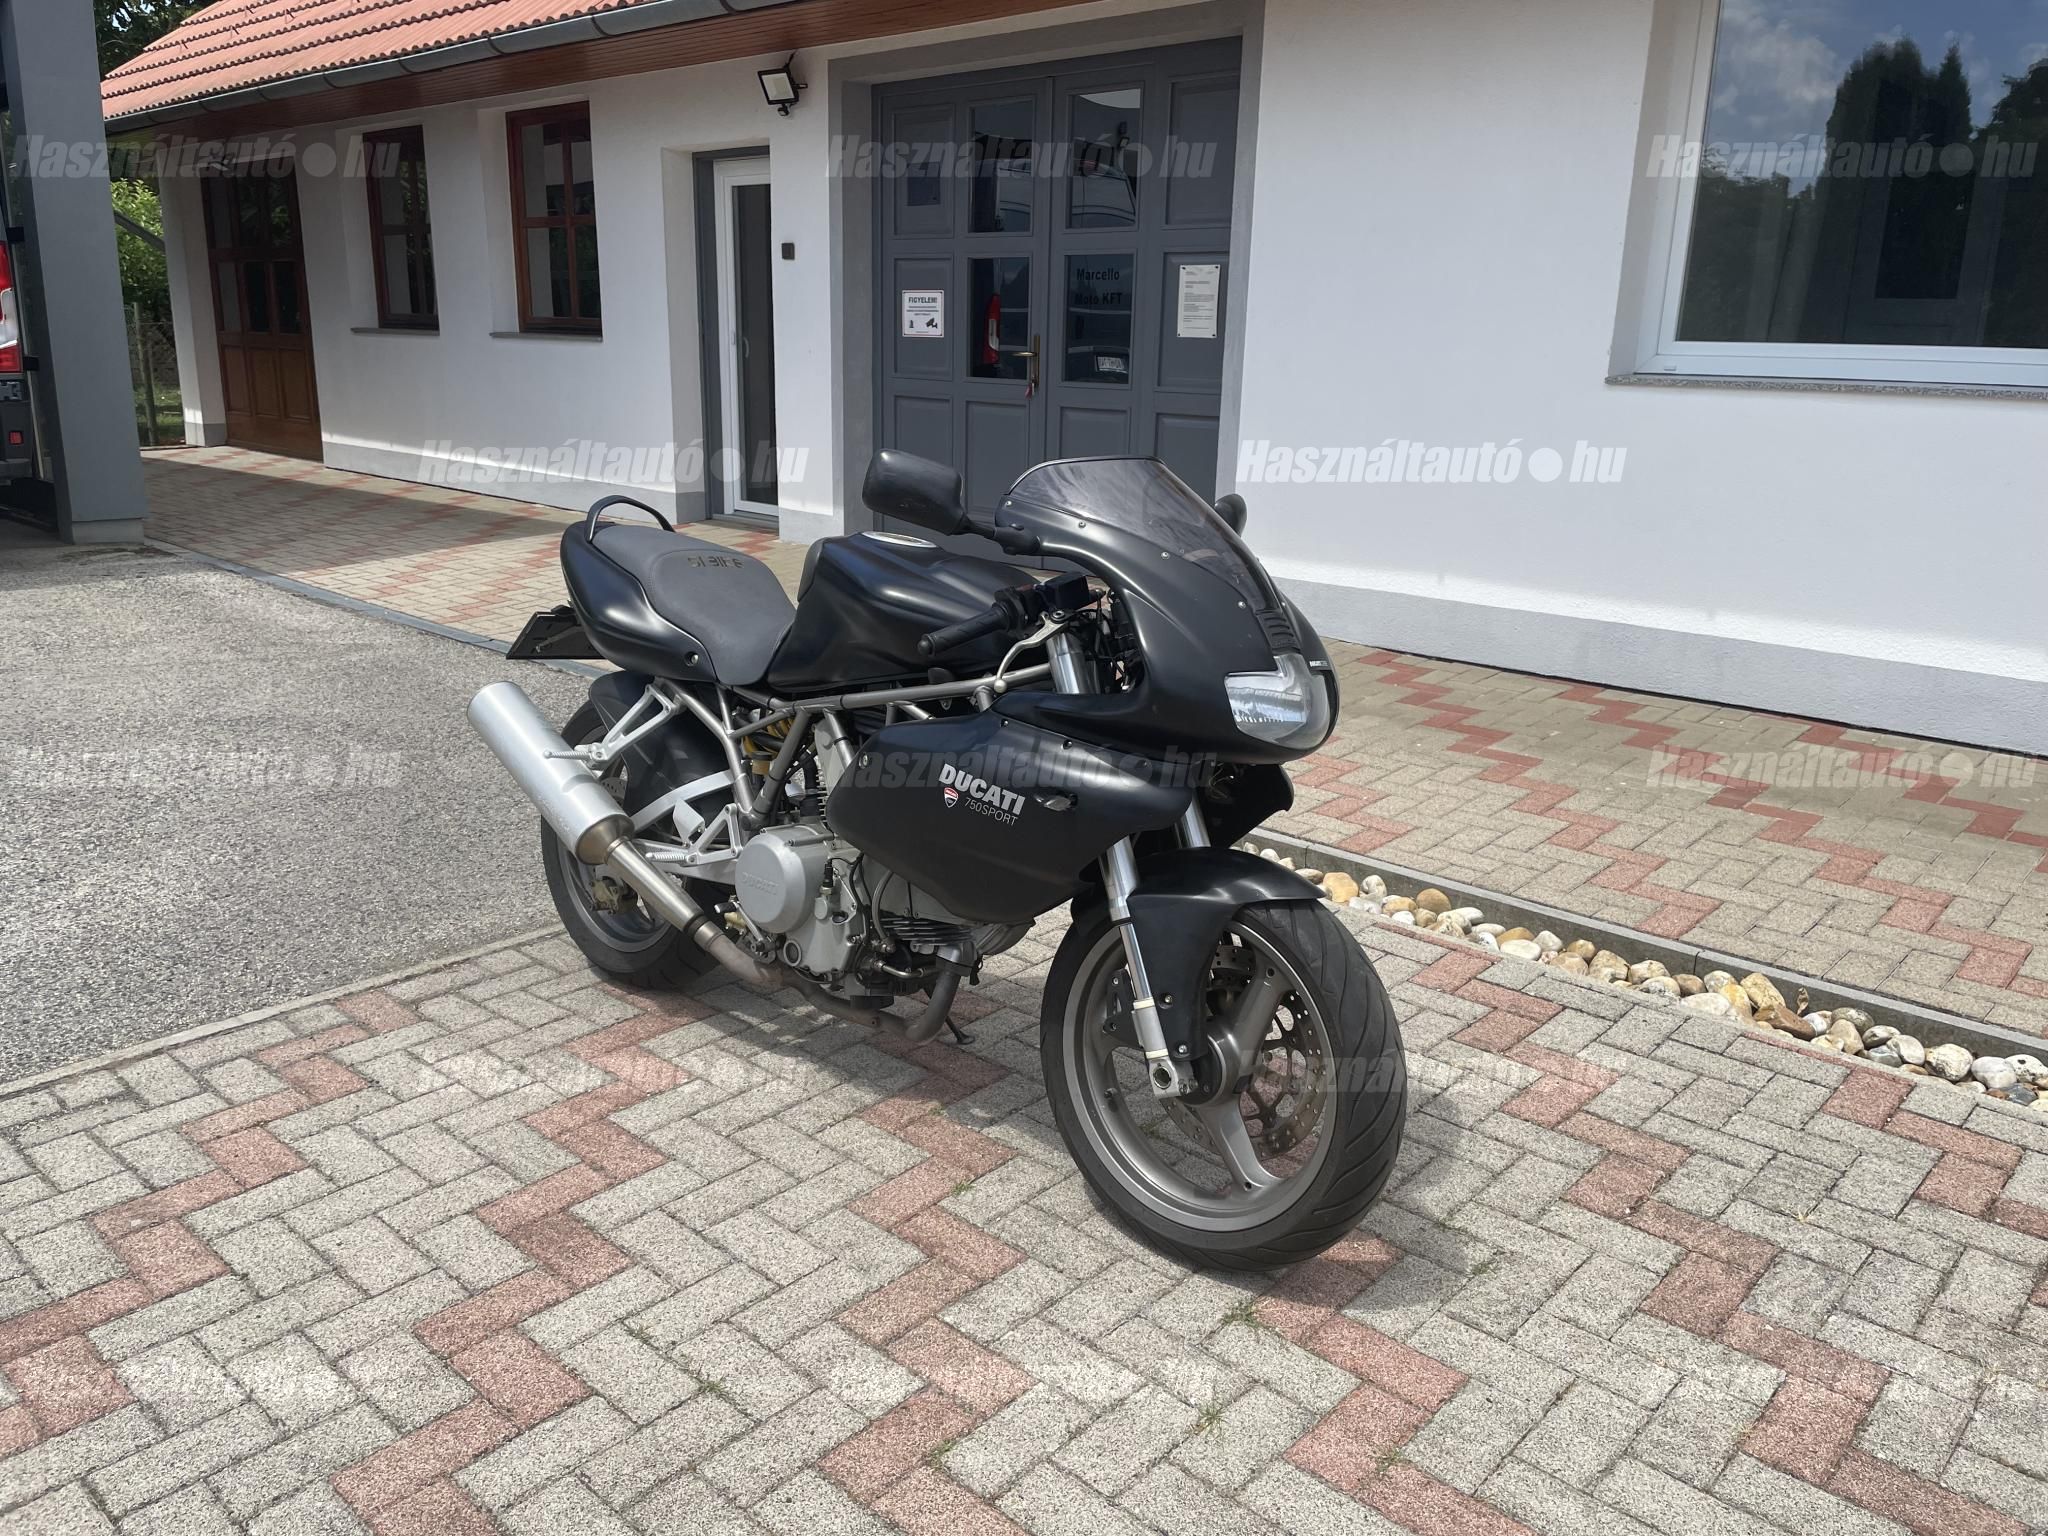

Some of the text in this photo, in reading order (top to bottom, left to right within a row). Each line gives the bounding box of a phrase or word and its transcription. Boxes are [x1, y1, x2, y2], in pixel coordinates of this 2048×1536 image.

[1077, 267, 1120, 280] Marcello
[1102, 291, 1123, 304] KFT
[938, 763, 1026, 815] DUCATI
[964, 797, 1019, 826] 750SPORT
